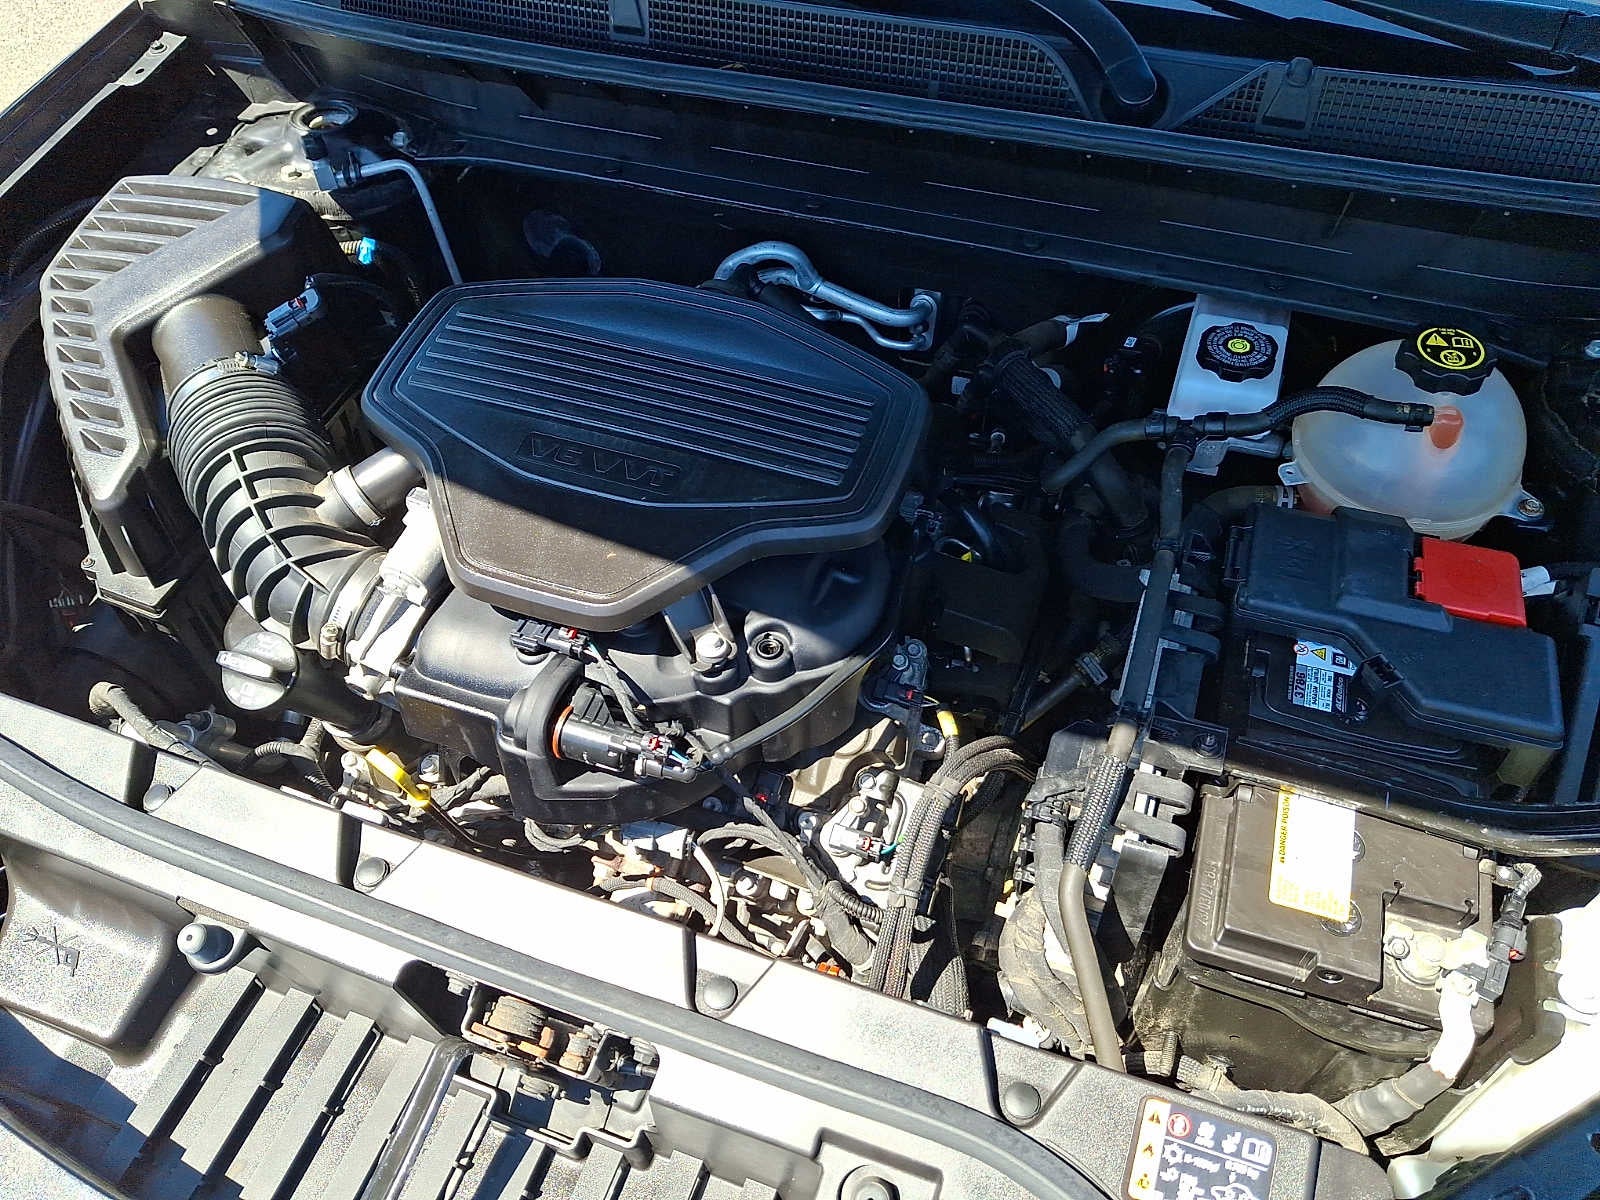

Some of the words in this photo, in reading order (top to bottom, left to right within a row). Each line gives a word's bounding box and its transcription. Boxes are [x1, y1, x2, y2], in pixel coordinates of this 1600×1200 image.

[531, 432, 584, 467] V6
[592, 448, 675, 488] VVT
[1335, 677, 1344, 710] ACDelco
[1281, 796, 1290, 824] POISON
[1279, 825, 1288, 856] DANGER
